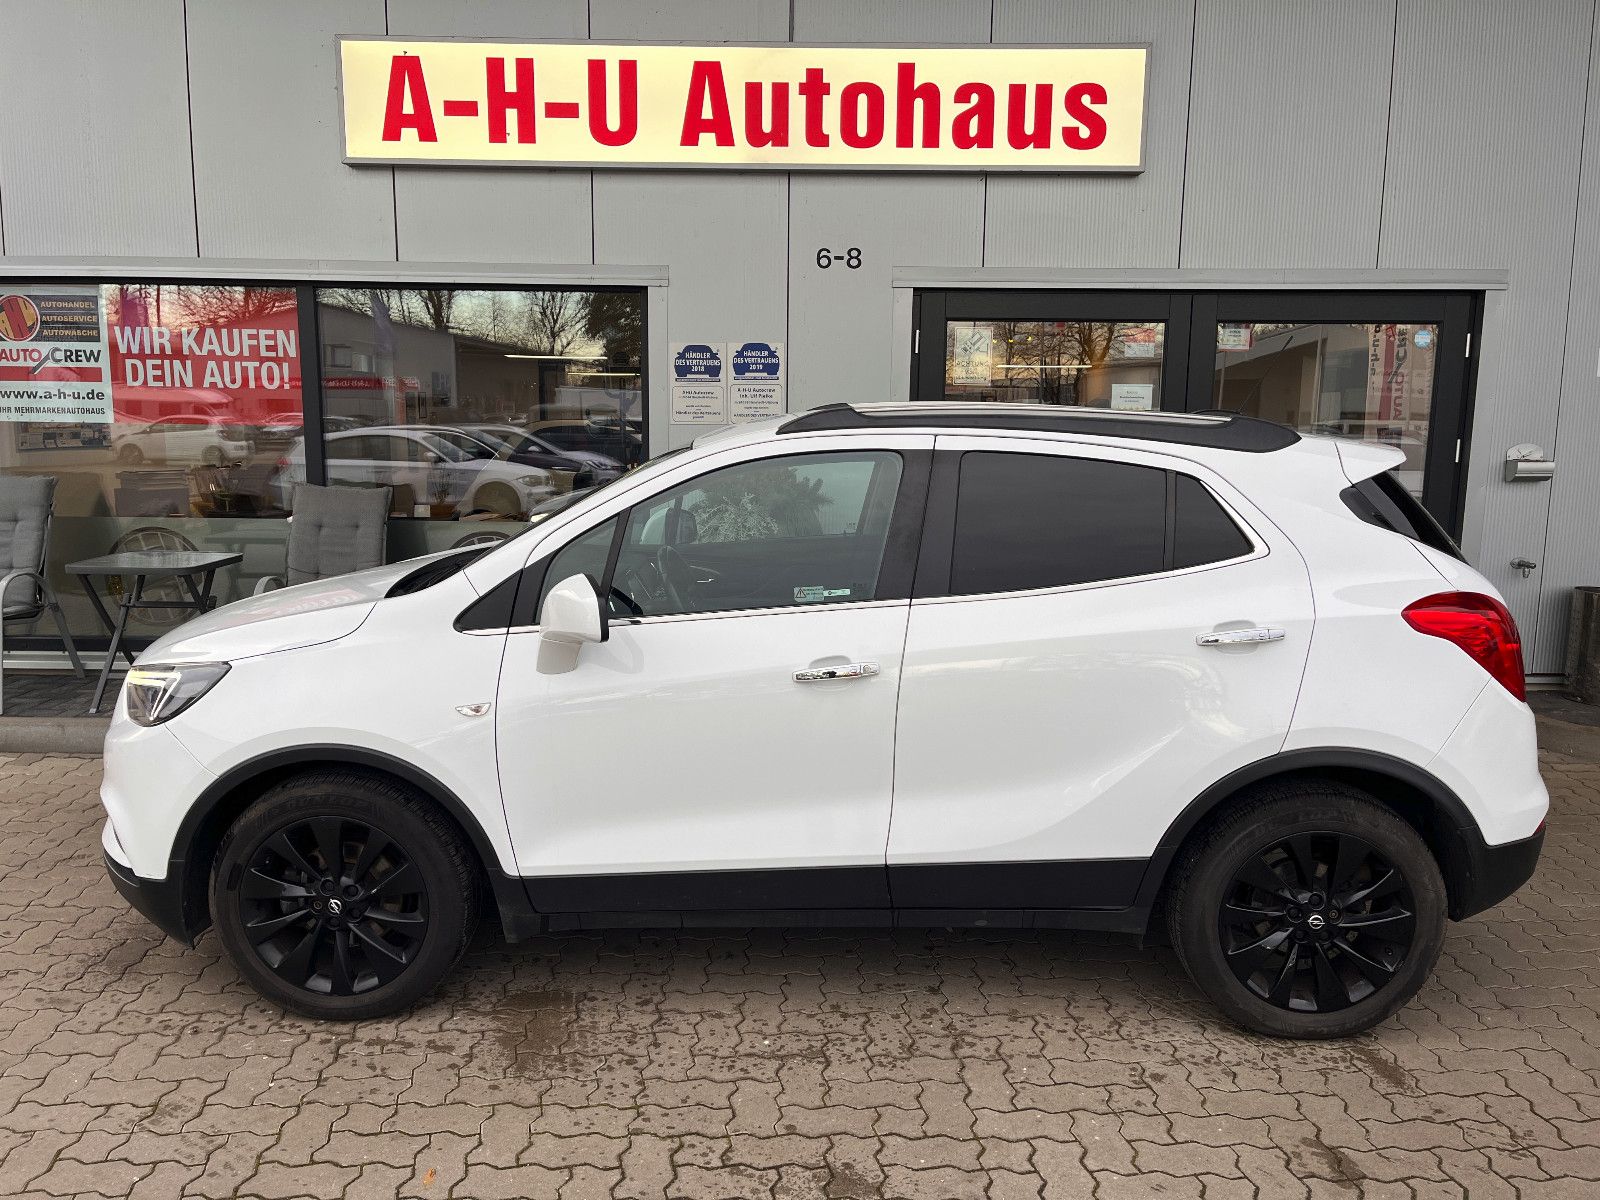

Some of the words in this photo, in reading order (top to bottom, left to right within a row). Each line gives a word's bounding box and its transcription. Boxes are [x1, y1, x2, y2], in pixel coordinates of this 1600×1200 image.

[382, 55, 638, 147] A-H-U
[680, 60, 1108, 150] Autohaus
[816, 247, 862, 269] 6-8
[114, 326, 172, 355] WIR
[181, 327, 297, 358] KAUFEN
[0, 348, 42, 362] AUTO
[50, 348, 101, 363] CREW
[685, 351, 711, 359] HÄNDLER
[743, 349, 769, 357] HÄNDLER
[125, 358, 193, 388] DEIN
[203, 360, 290, 390] AUTO!
[0, 388, 105, 400] www.a-h-u.de
[14, 406, 105, 415] MEHRMARKENAUTOHAUS
